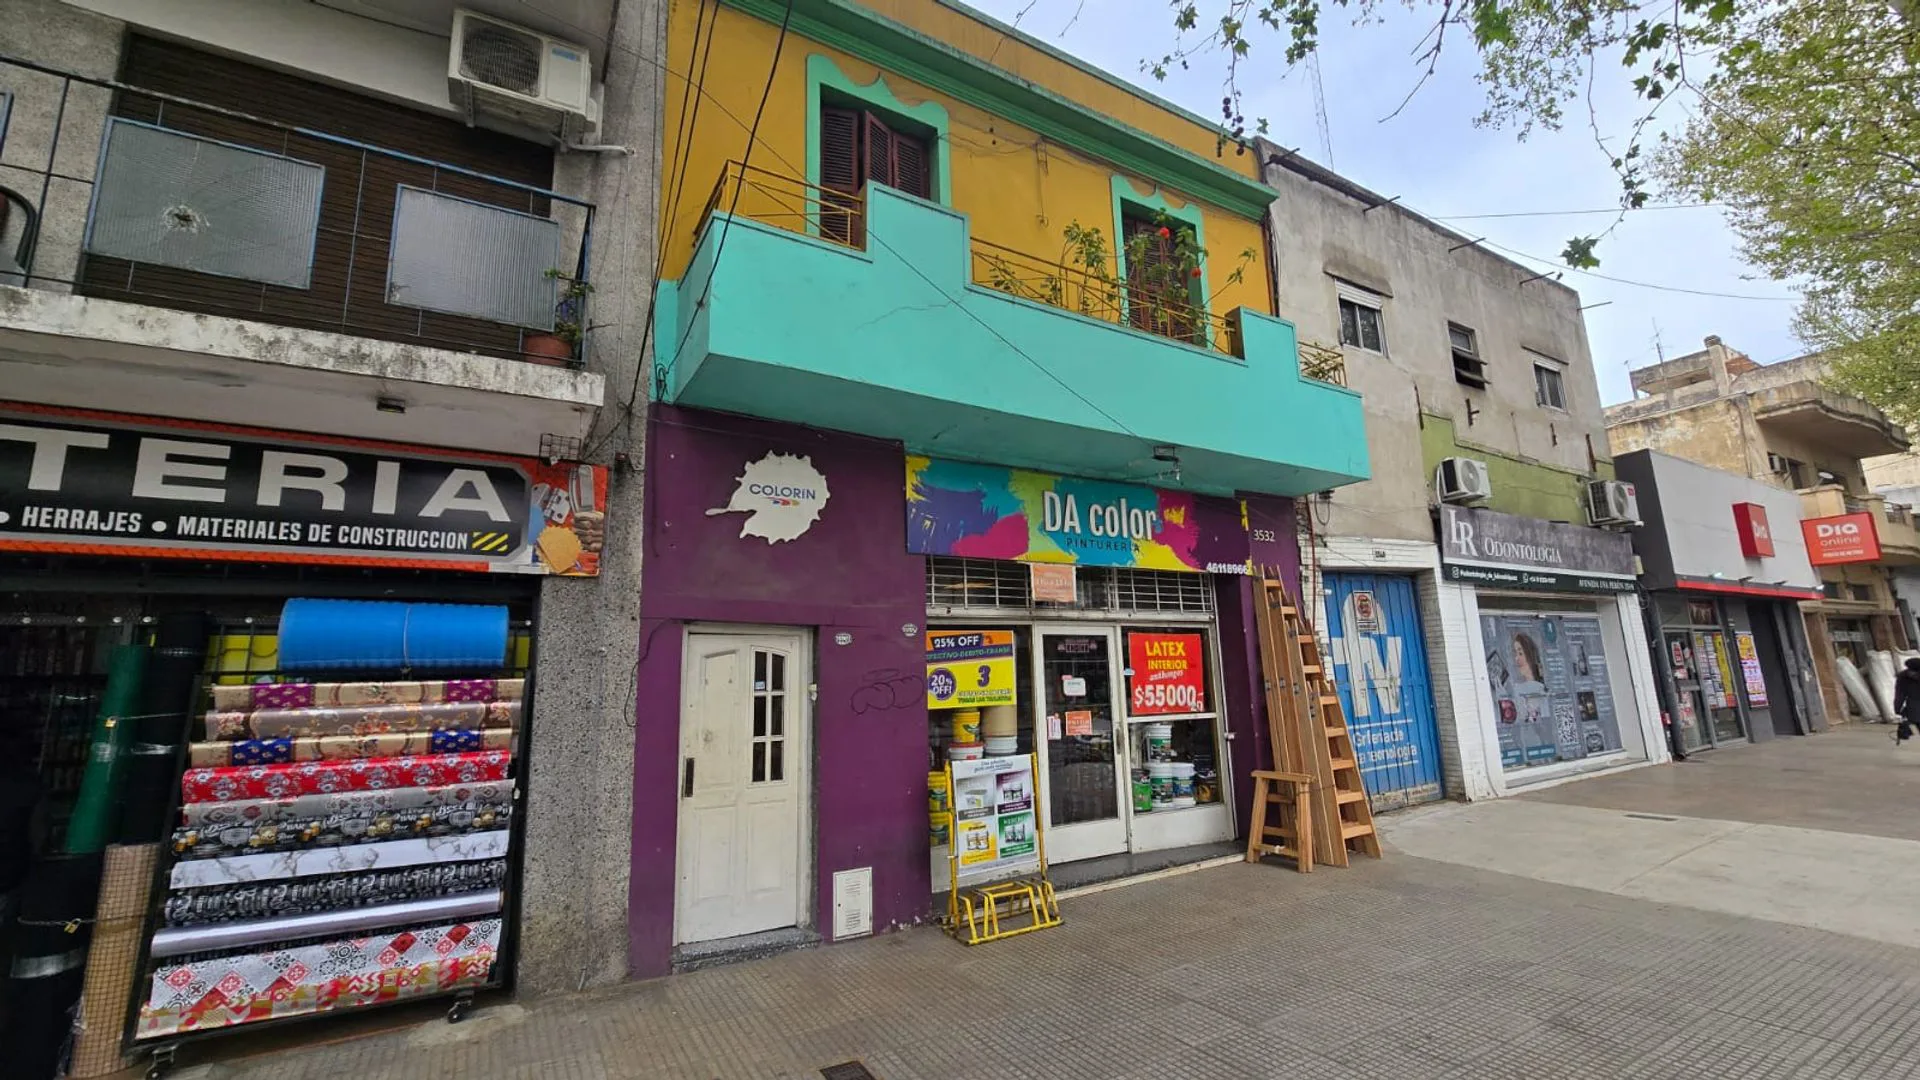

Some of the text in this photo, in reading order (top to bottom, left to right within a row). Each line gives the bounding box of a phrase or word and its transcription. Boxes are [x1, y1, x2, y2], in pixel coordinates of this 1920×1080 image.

[0, 423, 511, 522] TERIA
[749, 483, 816, 500] COLORIN
[1043, 490, 1157, 540] DA color
[21, 506, 468, 550] HERRAJES MATERIALES DE CONSTRUCCION
[1253, 529, 1276, 542] 3532
[1820, 536, 1861, 547] online
[934, 637, 956, 649] 25%
[957, 635, 980, 647] OFF
[1144, 640, 1186, 657] LATEX
[1147, 659, 1188, 670] INTERIOR
[931, 674, 953, 686] 20%
[977, 664, 991, 688] 3
[932, 685, 952, 695] OFF!
